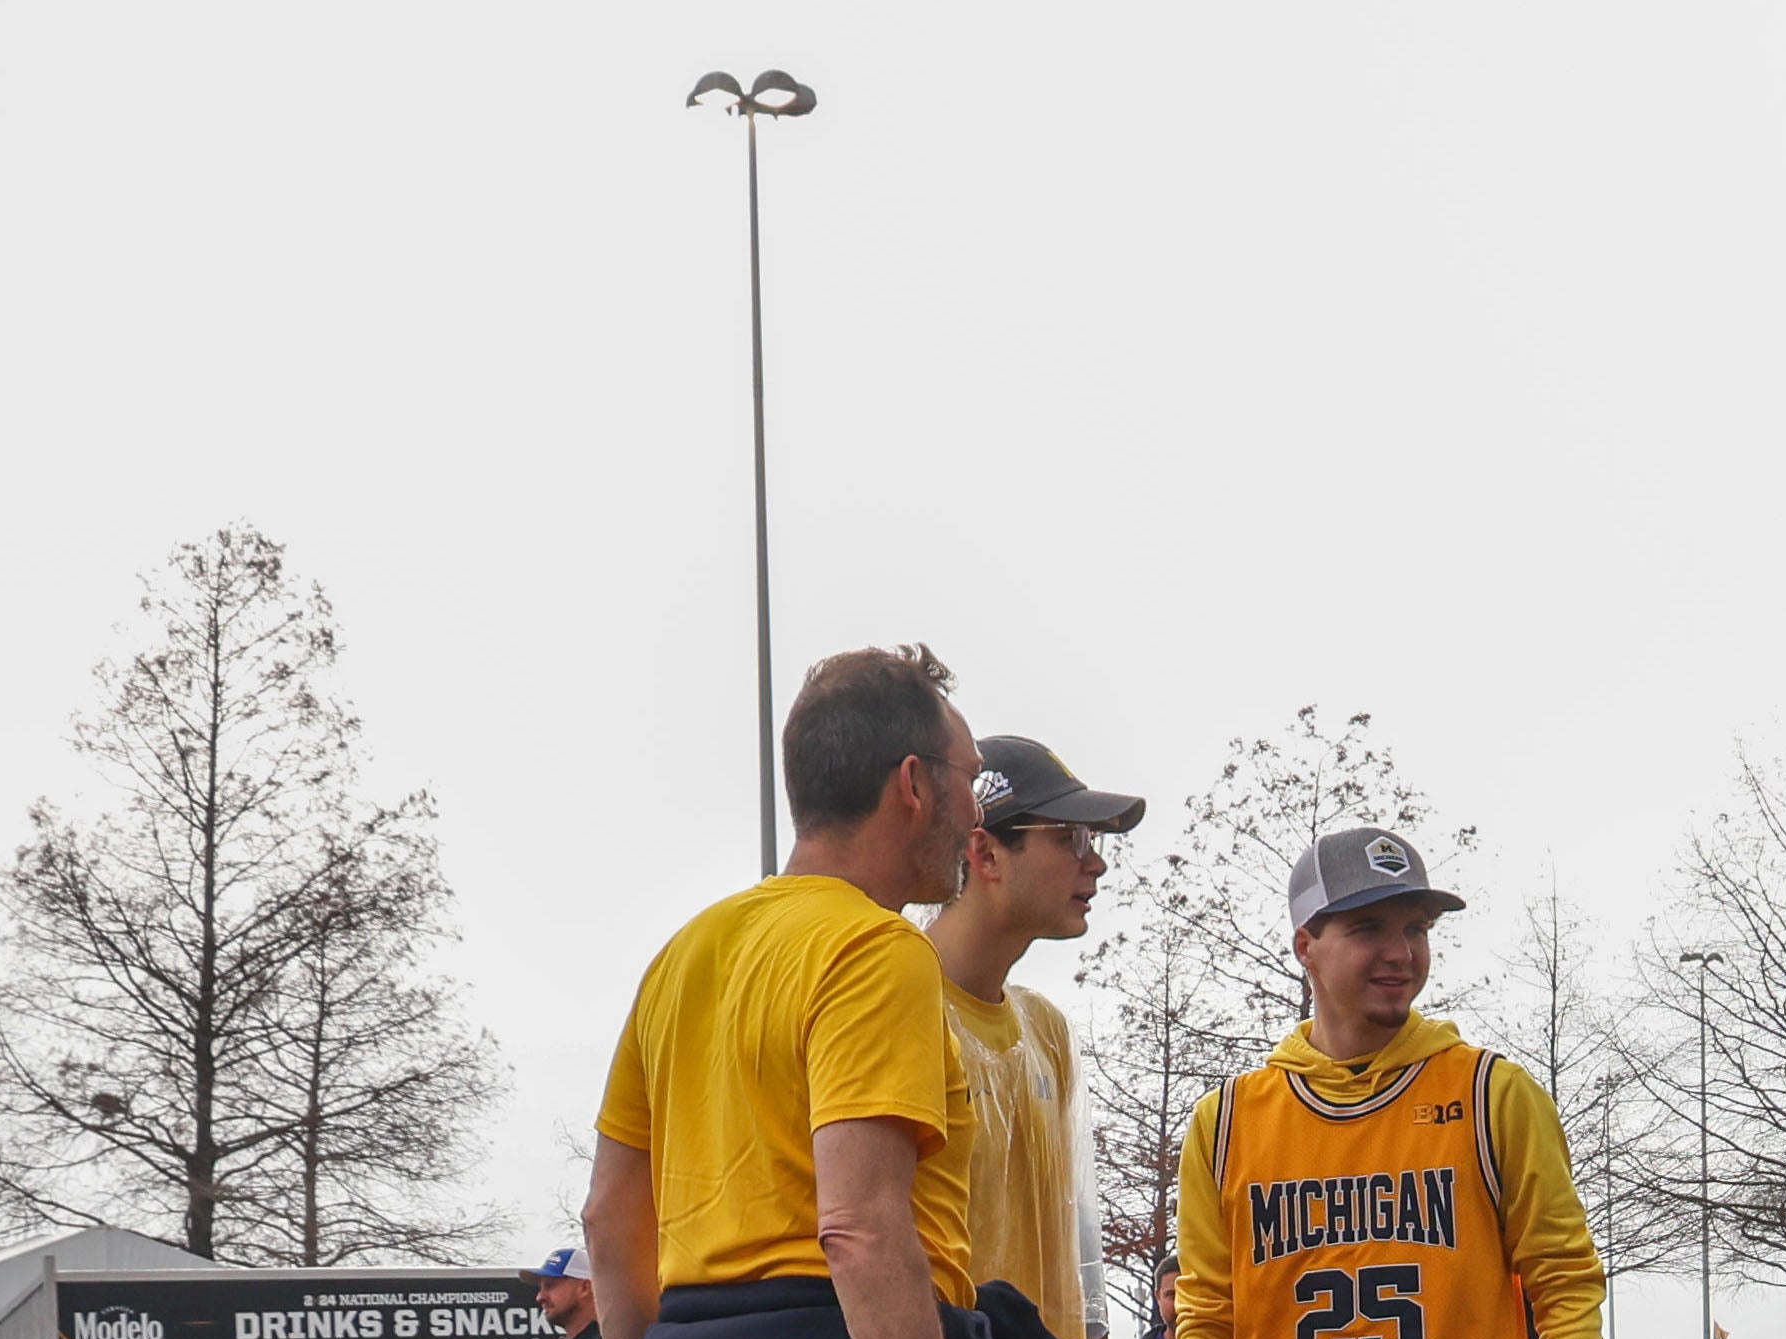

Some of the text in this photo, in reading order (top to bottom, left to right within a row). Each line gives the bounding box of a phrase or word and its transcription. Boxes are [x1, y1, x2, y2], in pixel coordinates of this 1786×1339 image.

[1248, 1166, 1457, 1267] MICHIGAN
[338, 1294, 407, 1306] NATIONAL
[408, 1291, 509, 1305] CHAMPIONSHIP
[394, 1309, 420, 1338] &
